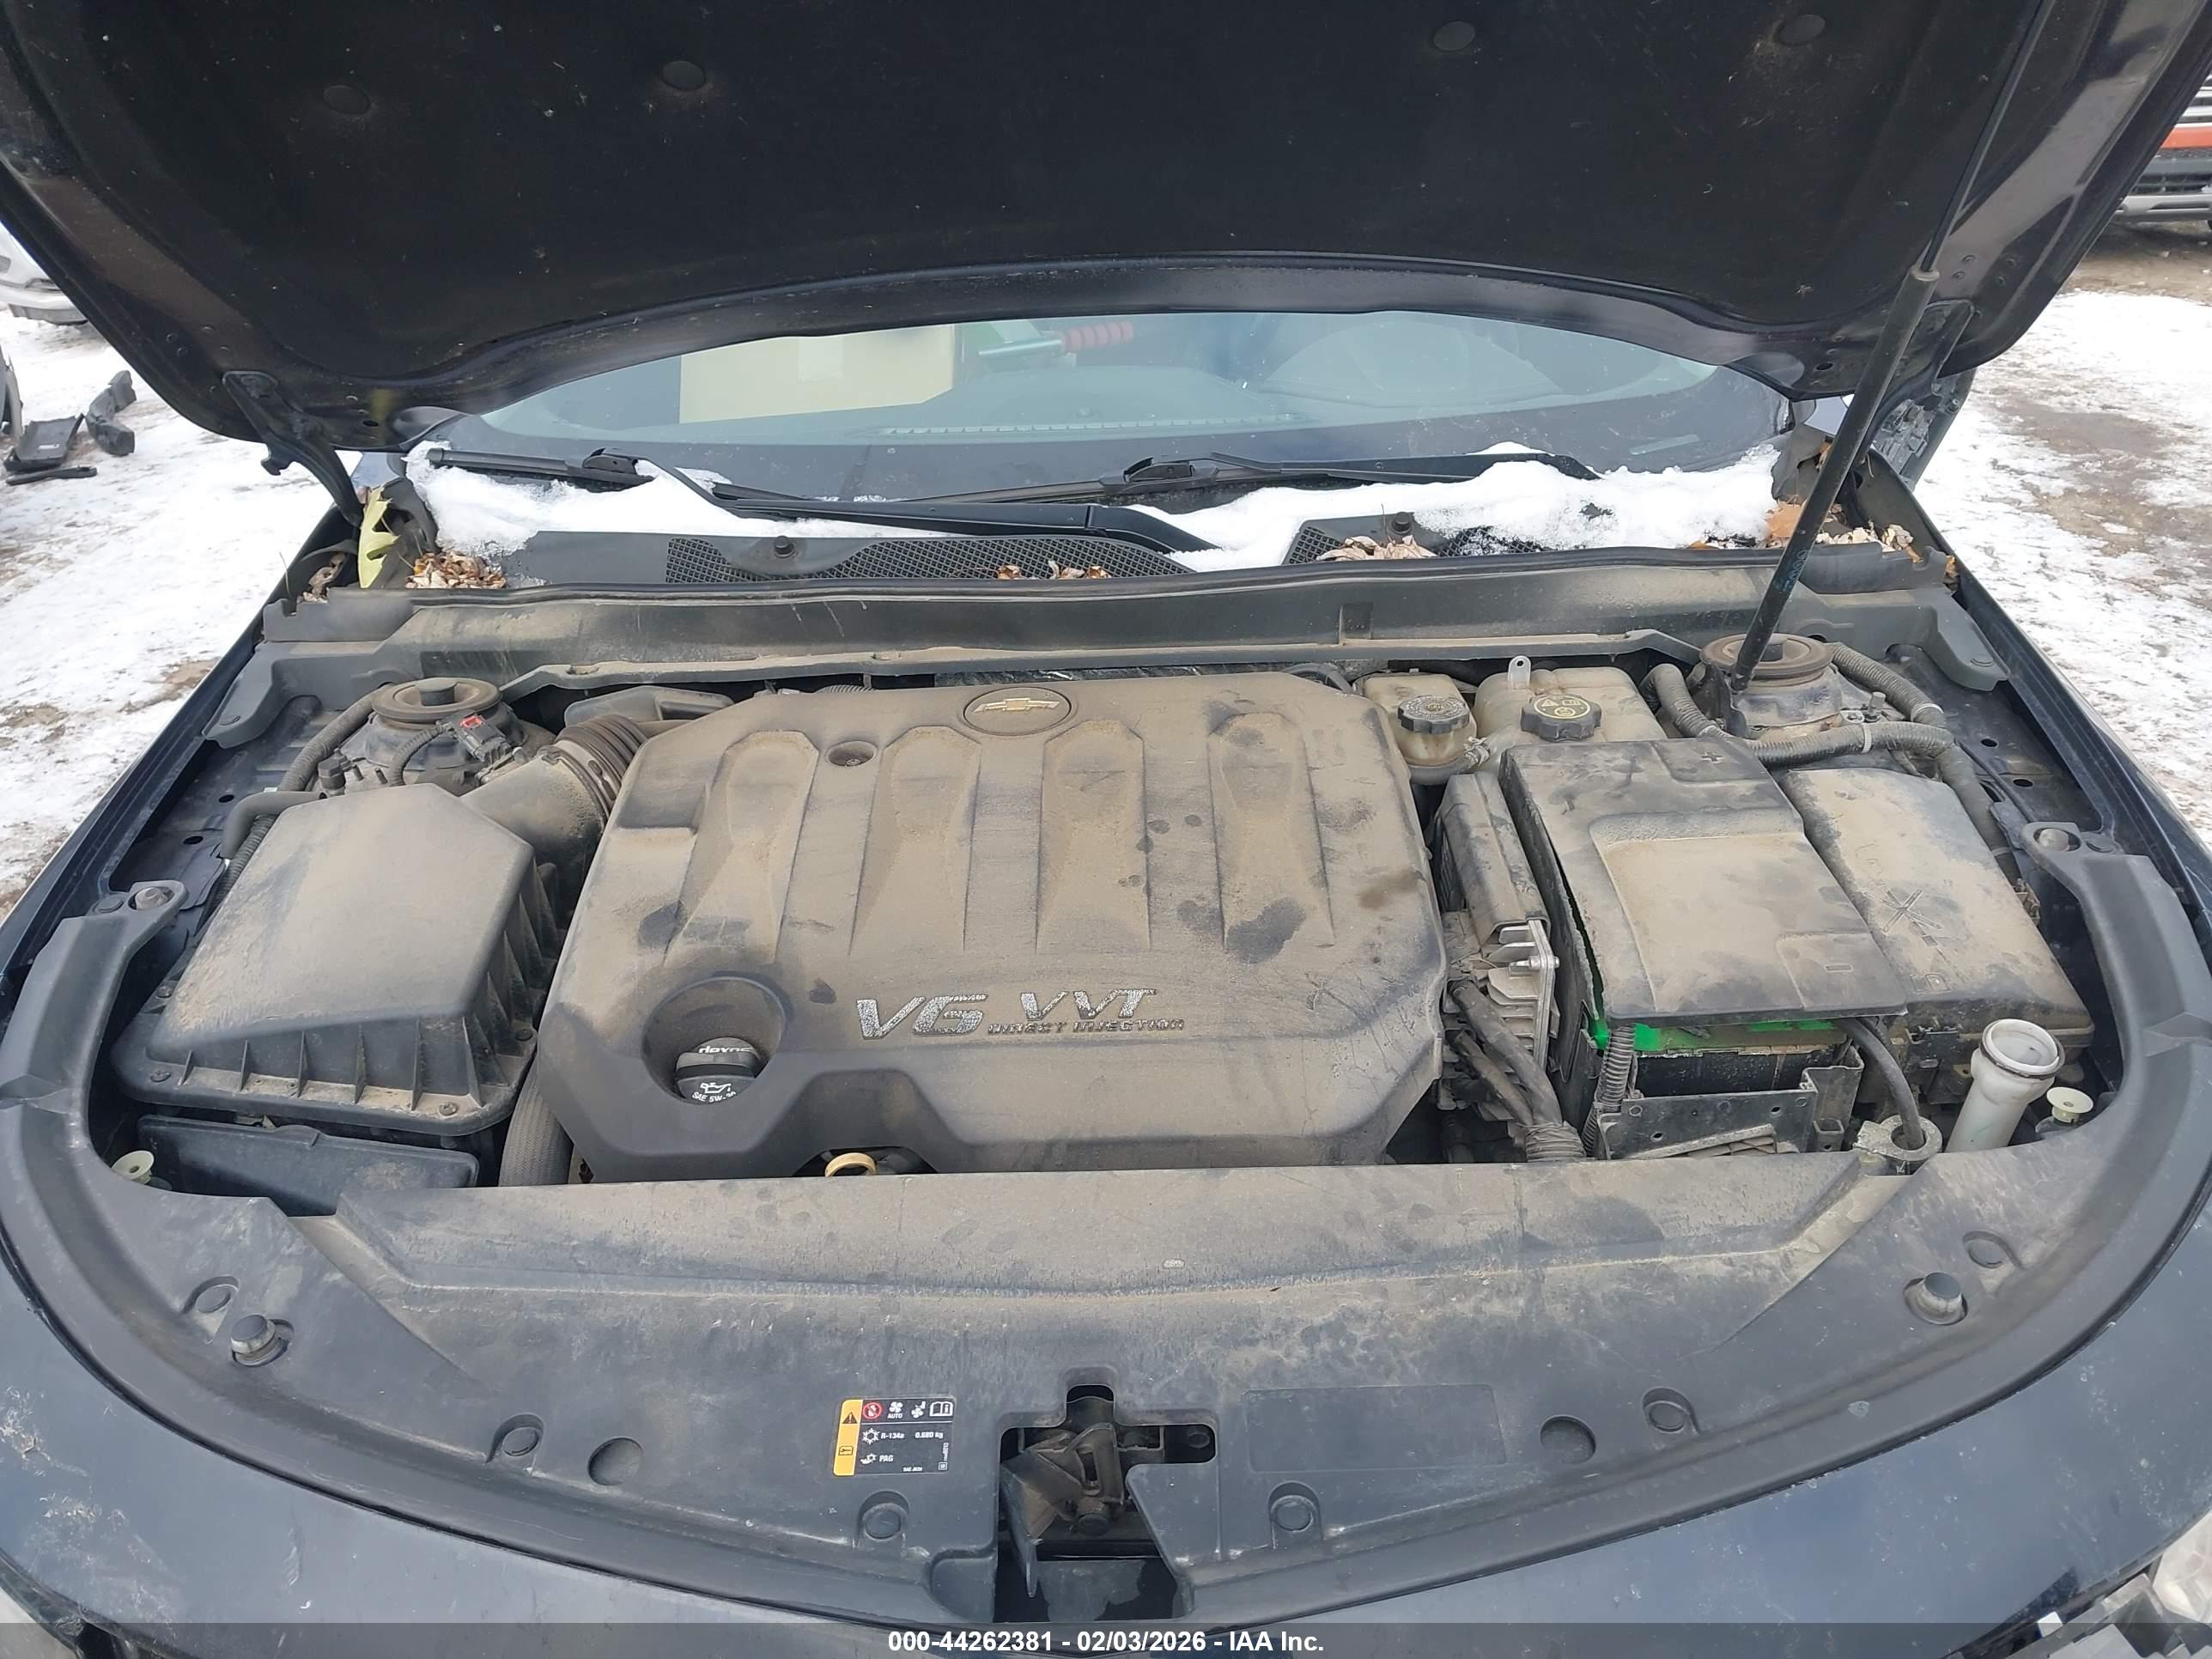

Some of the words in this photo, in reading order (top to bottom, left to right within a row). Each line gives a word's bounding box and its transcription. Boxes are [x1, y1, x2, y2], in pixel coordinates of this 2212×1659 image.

[856, 993, 988, 1040] V6
[1019, 988, 1157, 1020] VVT
[988, 1022, 1067, 1035] DIRECT
[1073, 1018, 1184, 1033] INJECTION
[691, 1091, 708, 1103] SAE
